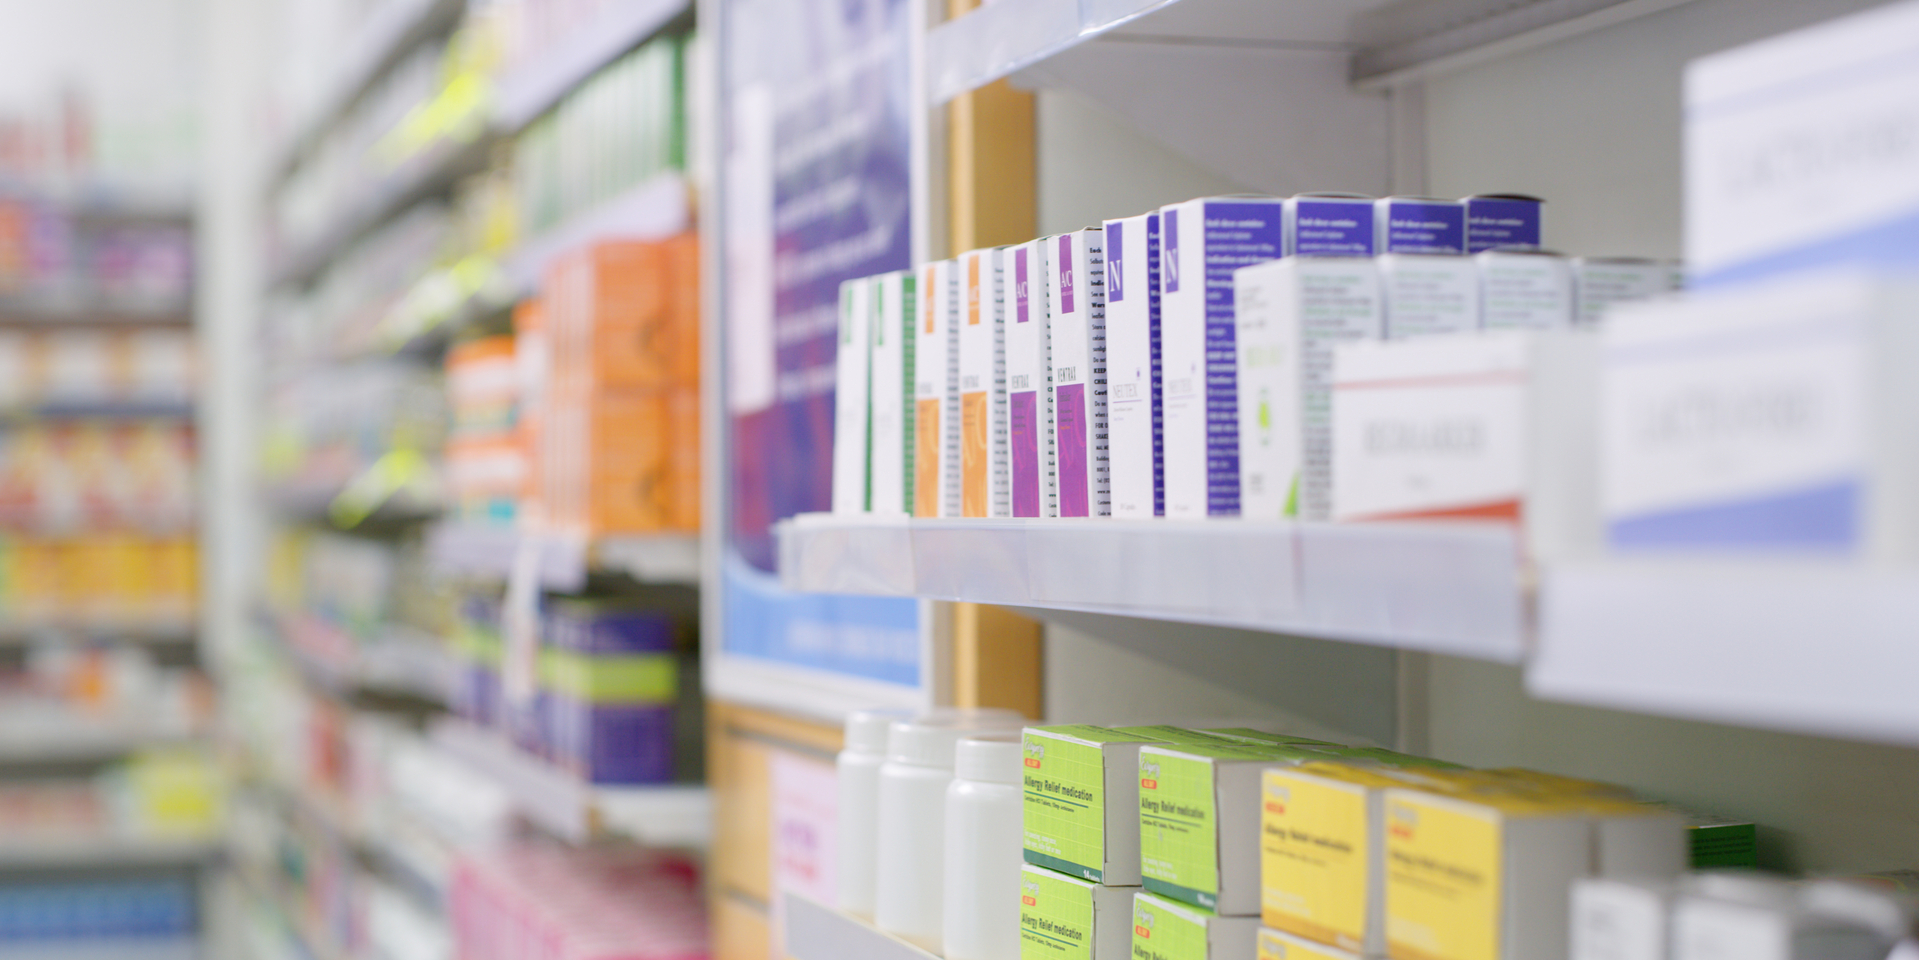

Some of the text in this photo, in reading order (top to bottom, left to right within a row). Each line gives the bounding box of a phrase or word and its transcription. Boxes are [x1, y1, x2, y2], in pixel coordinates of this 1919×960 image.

[1109, 259, 1121, 292] N
[1165, 248, 1177, 284] N
[1057, 366, 1077, 383] VENTRAX
[1112, 383, 1138, 399] NEUTEX
[1025, 775, 1093, 802] Allergy Relief medication
[1141, 797, 1204, 819] Allergy Relief medication
[1021, 913, 1082, 941] Allergy Relief medication
